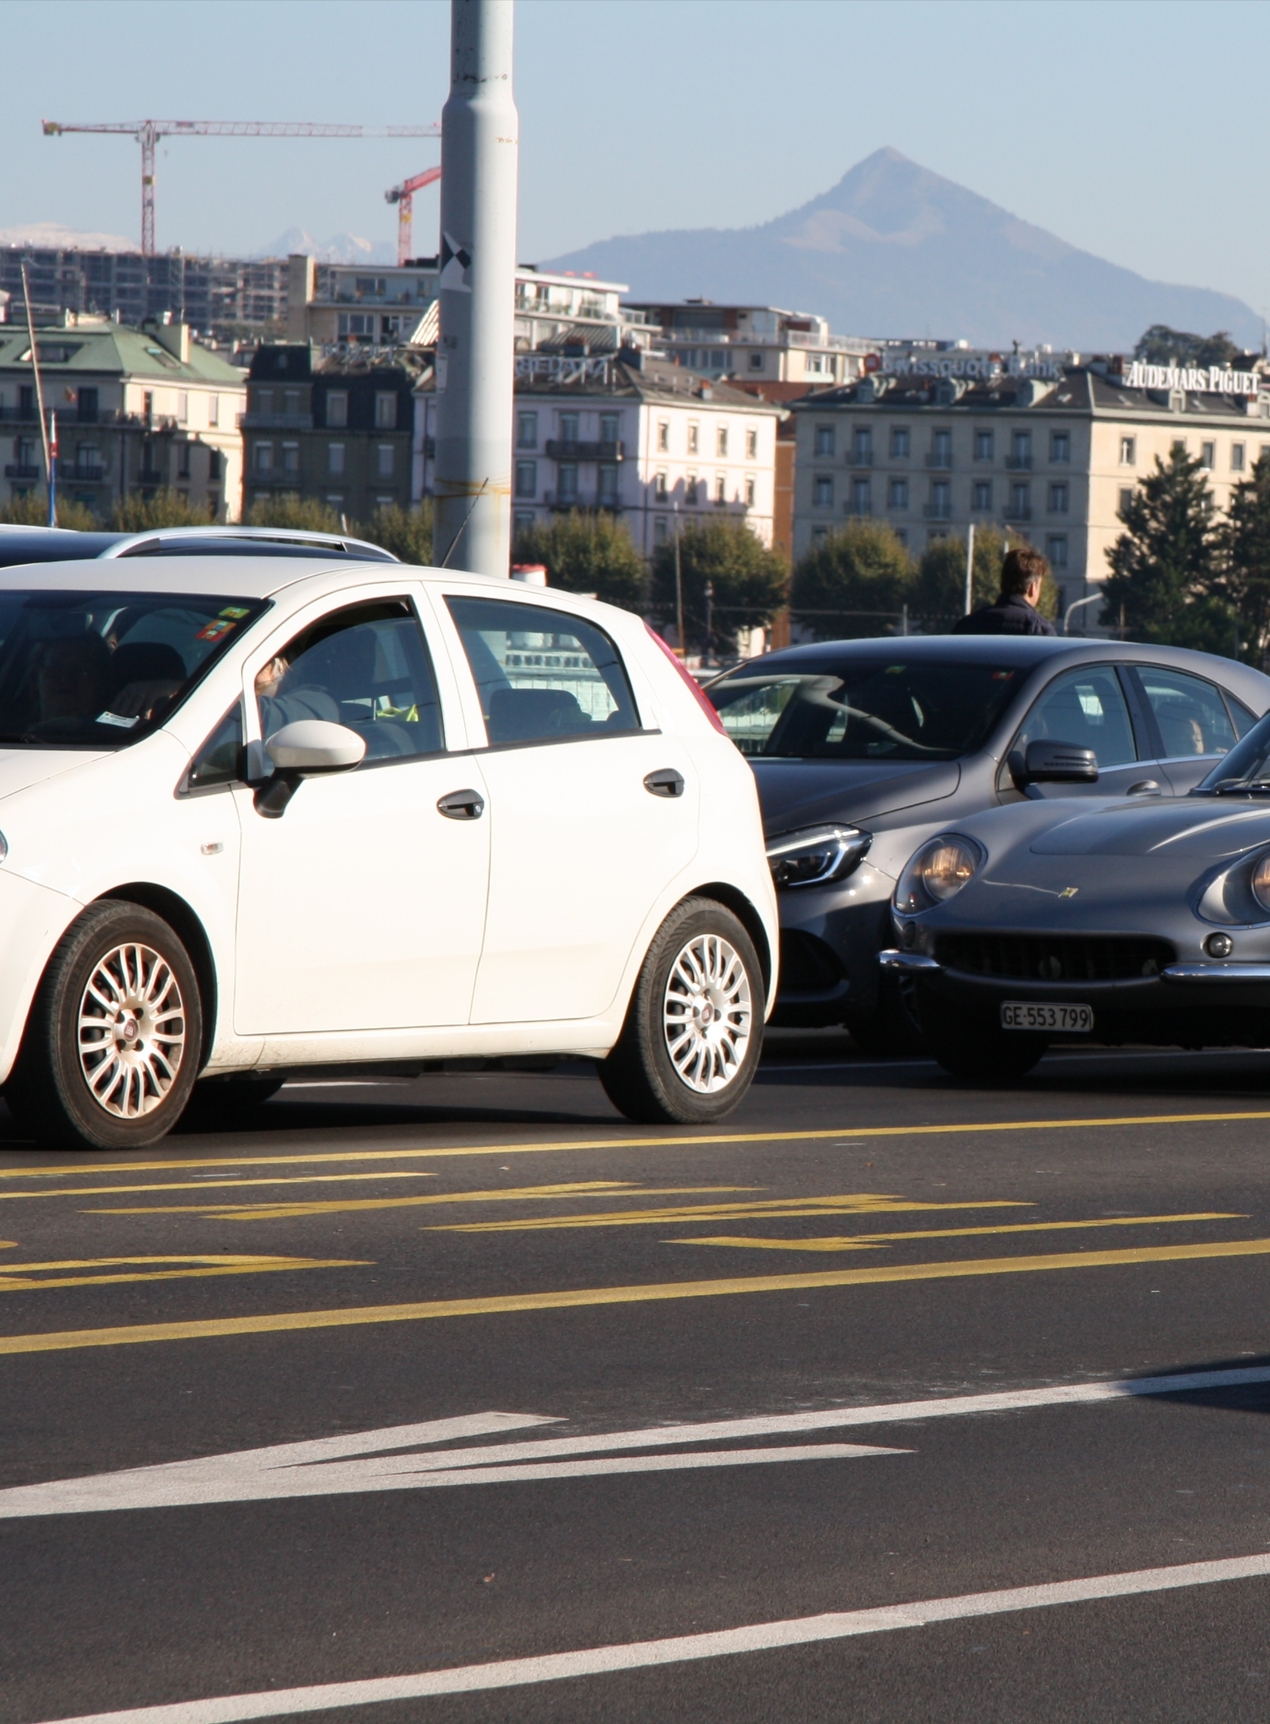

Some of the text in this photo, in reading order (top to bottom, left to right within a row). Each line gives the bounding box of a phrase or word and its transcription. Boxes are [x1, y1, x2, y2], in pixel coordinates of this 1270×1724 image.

[1008, 356, 1060, 377] Bank
[1126, 361, 1261, 394] AUDEMARS PIGUET
